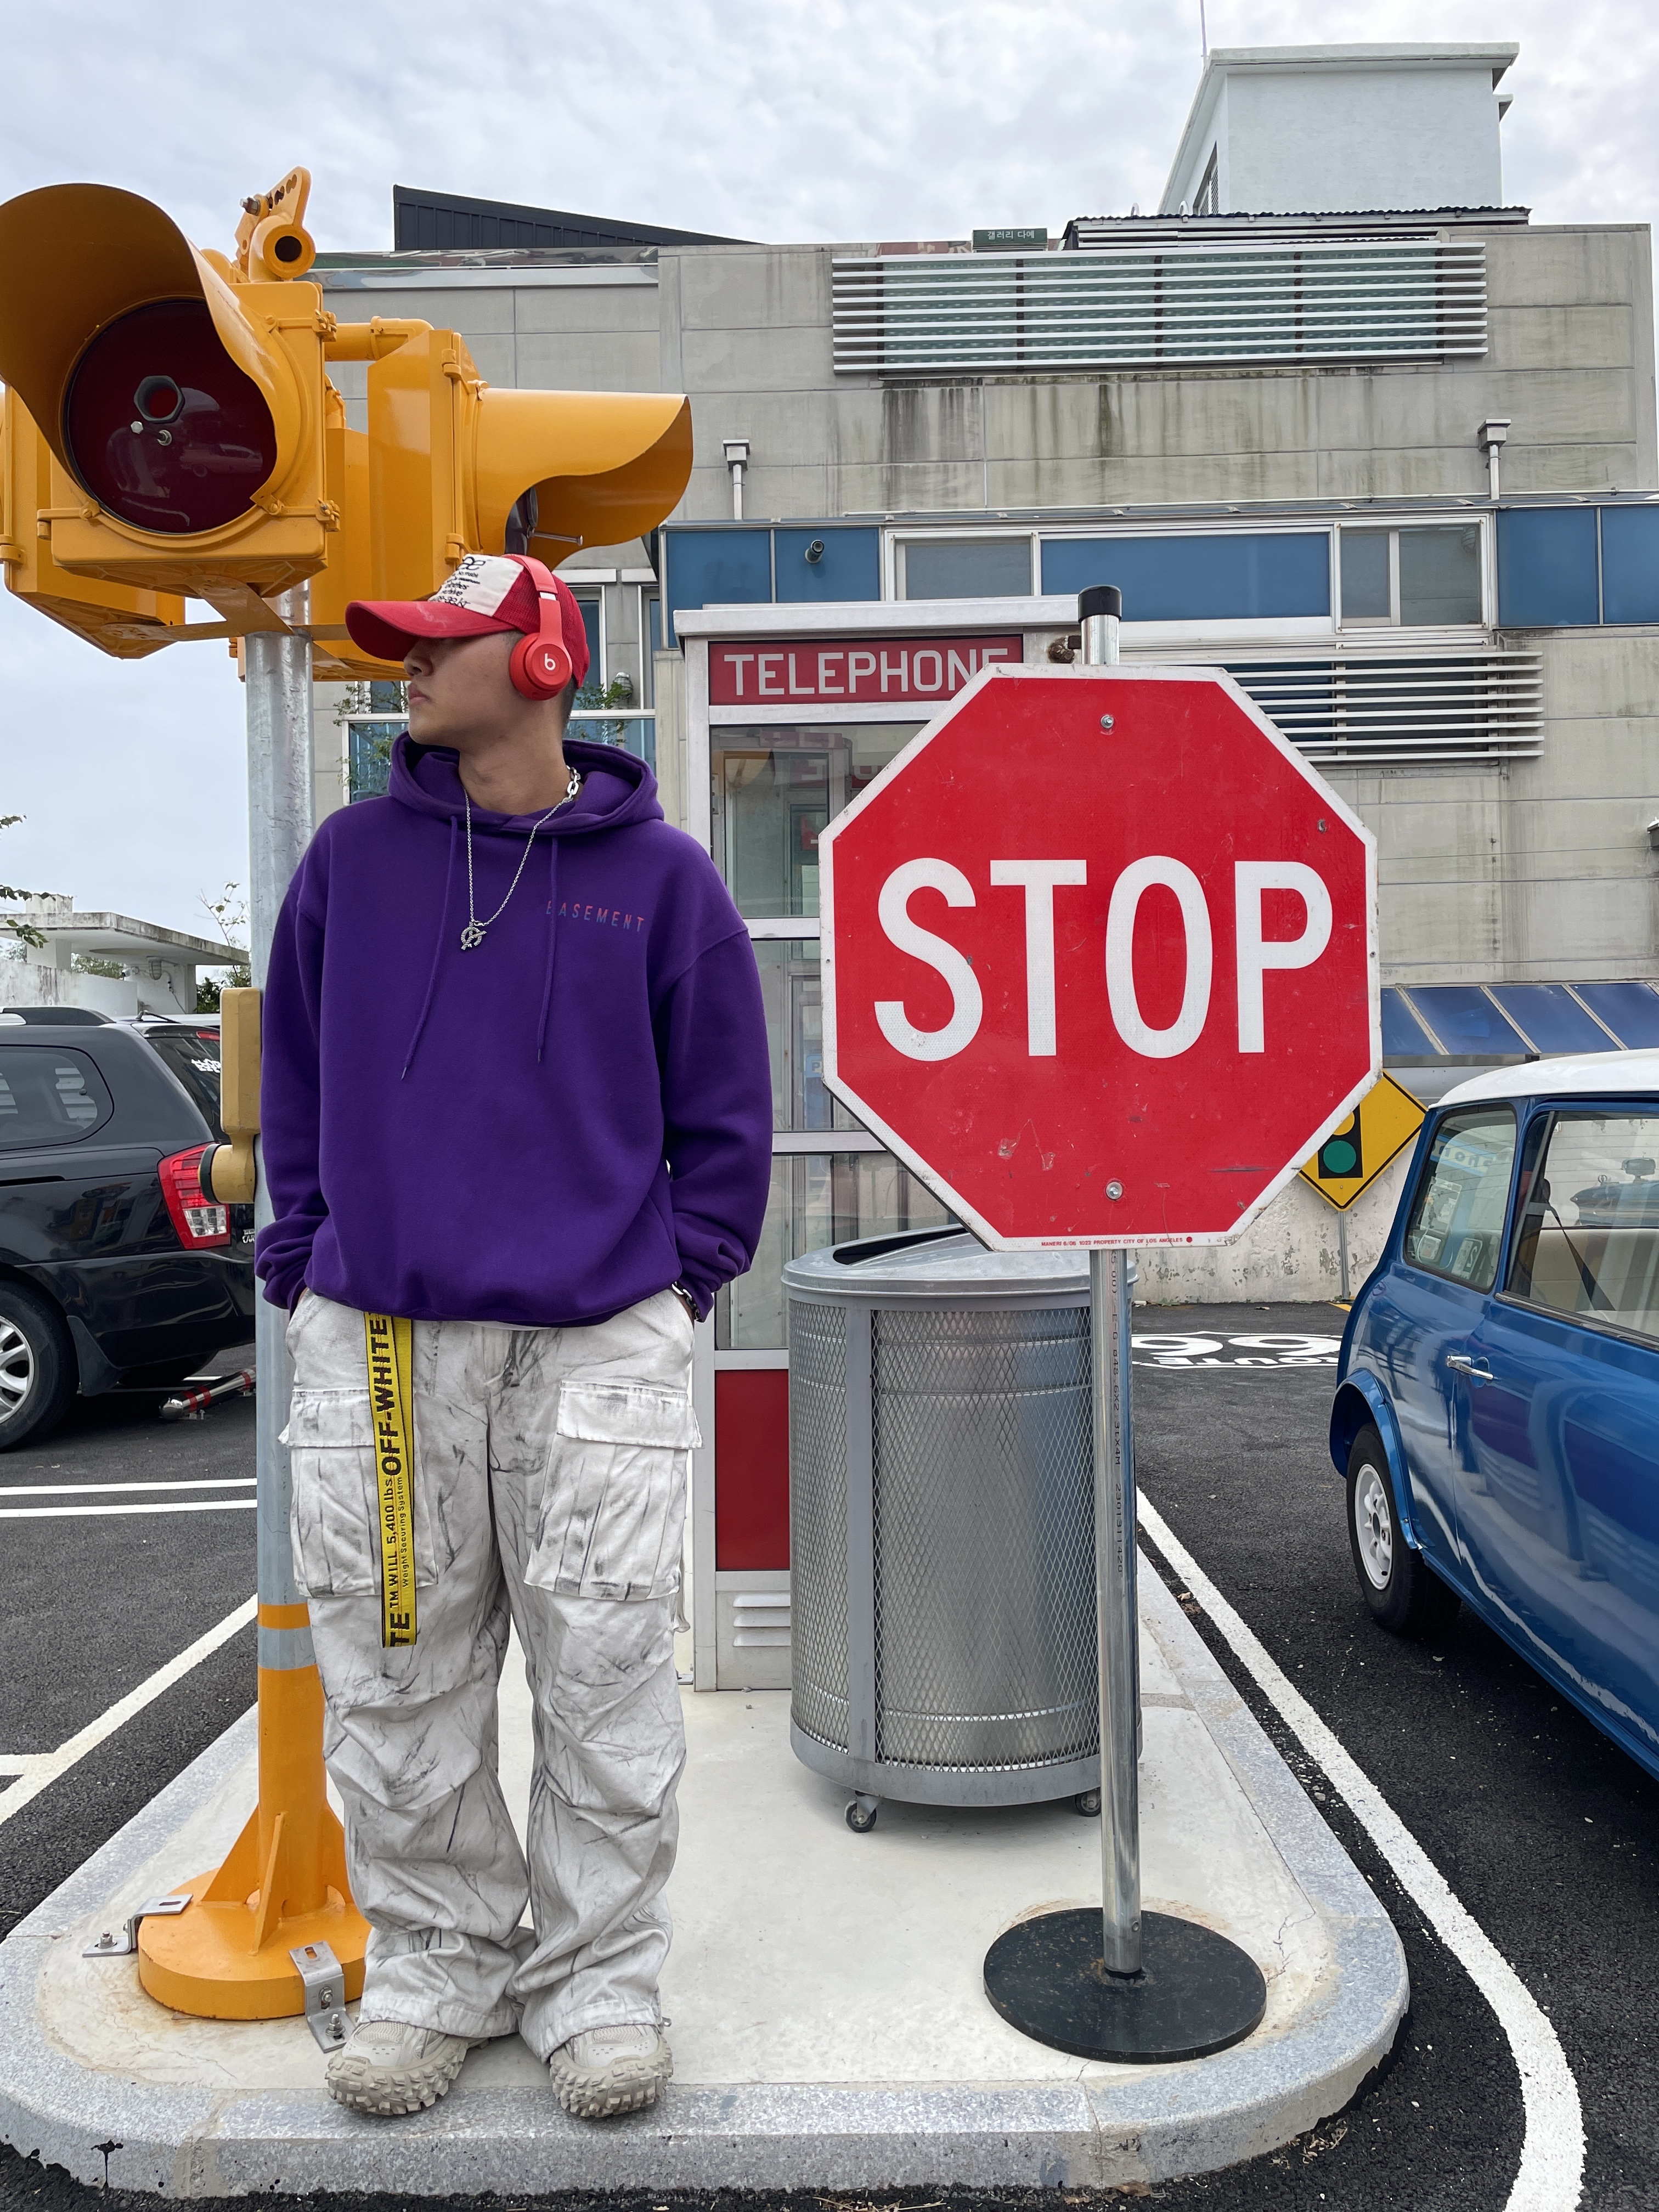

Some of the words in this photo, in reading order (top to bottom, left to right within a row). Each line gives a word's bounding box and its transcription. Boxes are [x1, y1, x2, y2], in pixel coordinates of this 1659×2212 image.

[988, 230, 1014, 240] 갤러리
[874, 855, 1333, 1062] STOP
[369, 1319, 402, 1476] OFF-WHITE
[397, 1476, 405, 1511] System
[385, 1505, 398, 1544] 5,400
[387, 1551, 398, 1587] WILL
[390, 1590, 399, 1609] TM
